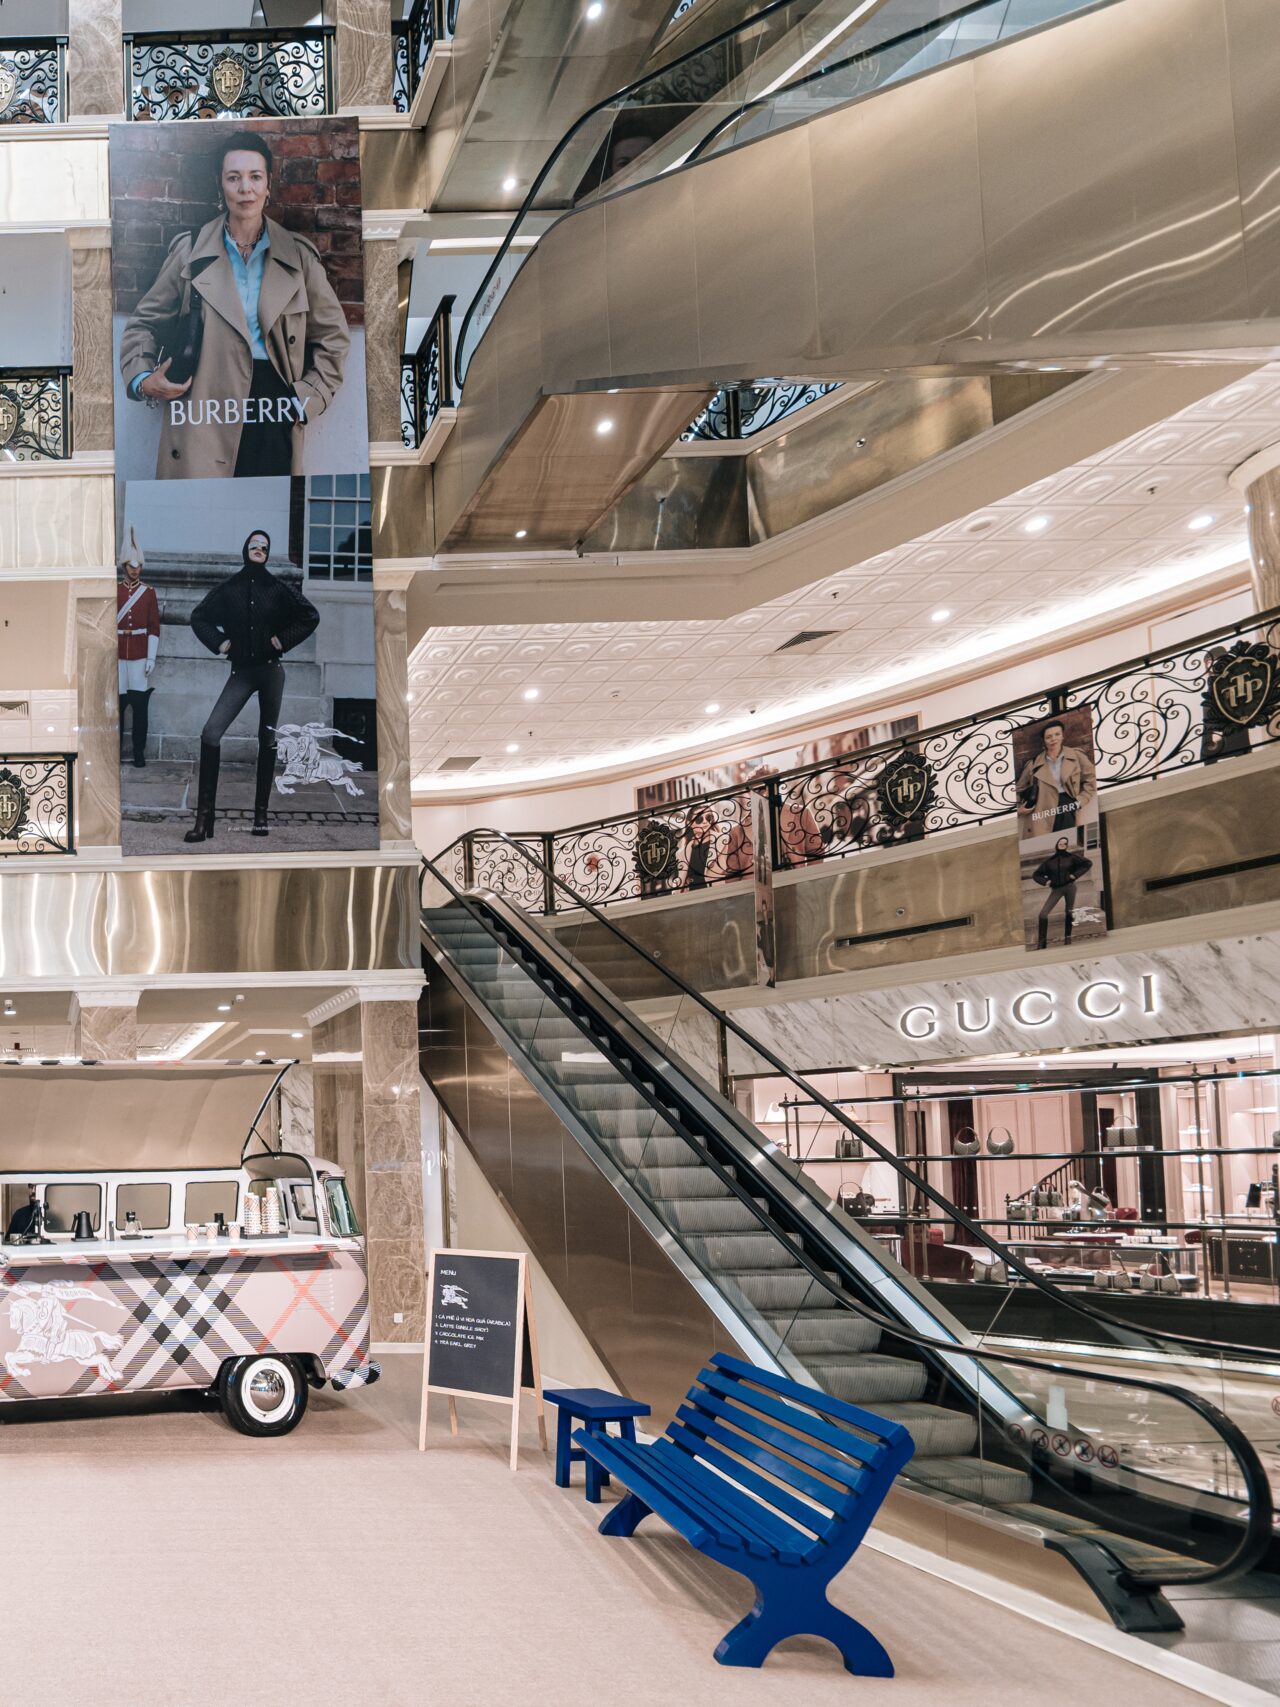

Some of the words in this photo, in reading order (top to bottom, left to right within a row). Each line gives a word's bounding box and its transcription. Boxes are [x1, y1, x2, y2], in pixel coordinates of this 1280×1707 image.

[169, 396, 310, 428] BURBERRY
[1031, 801, 1081, 821] BURBERRY
[898, 973, 1158, 1040] GUCCI
